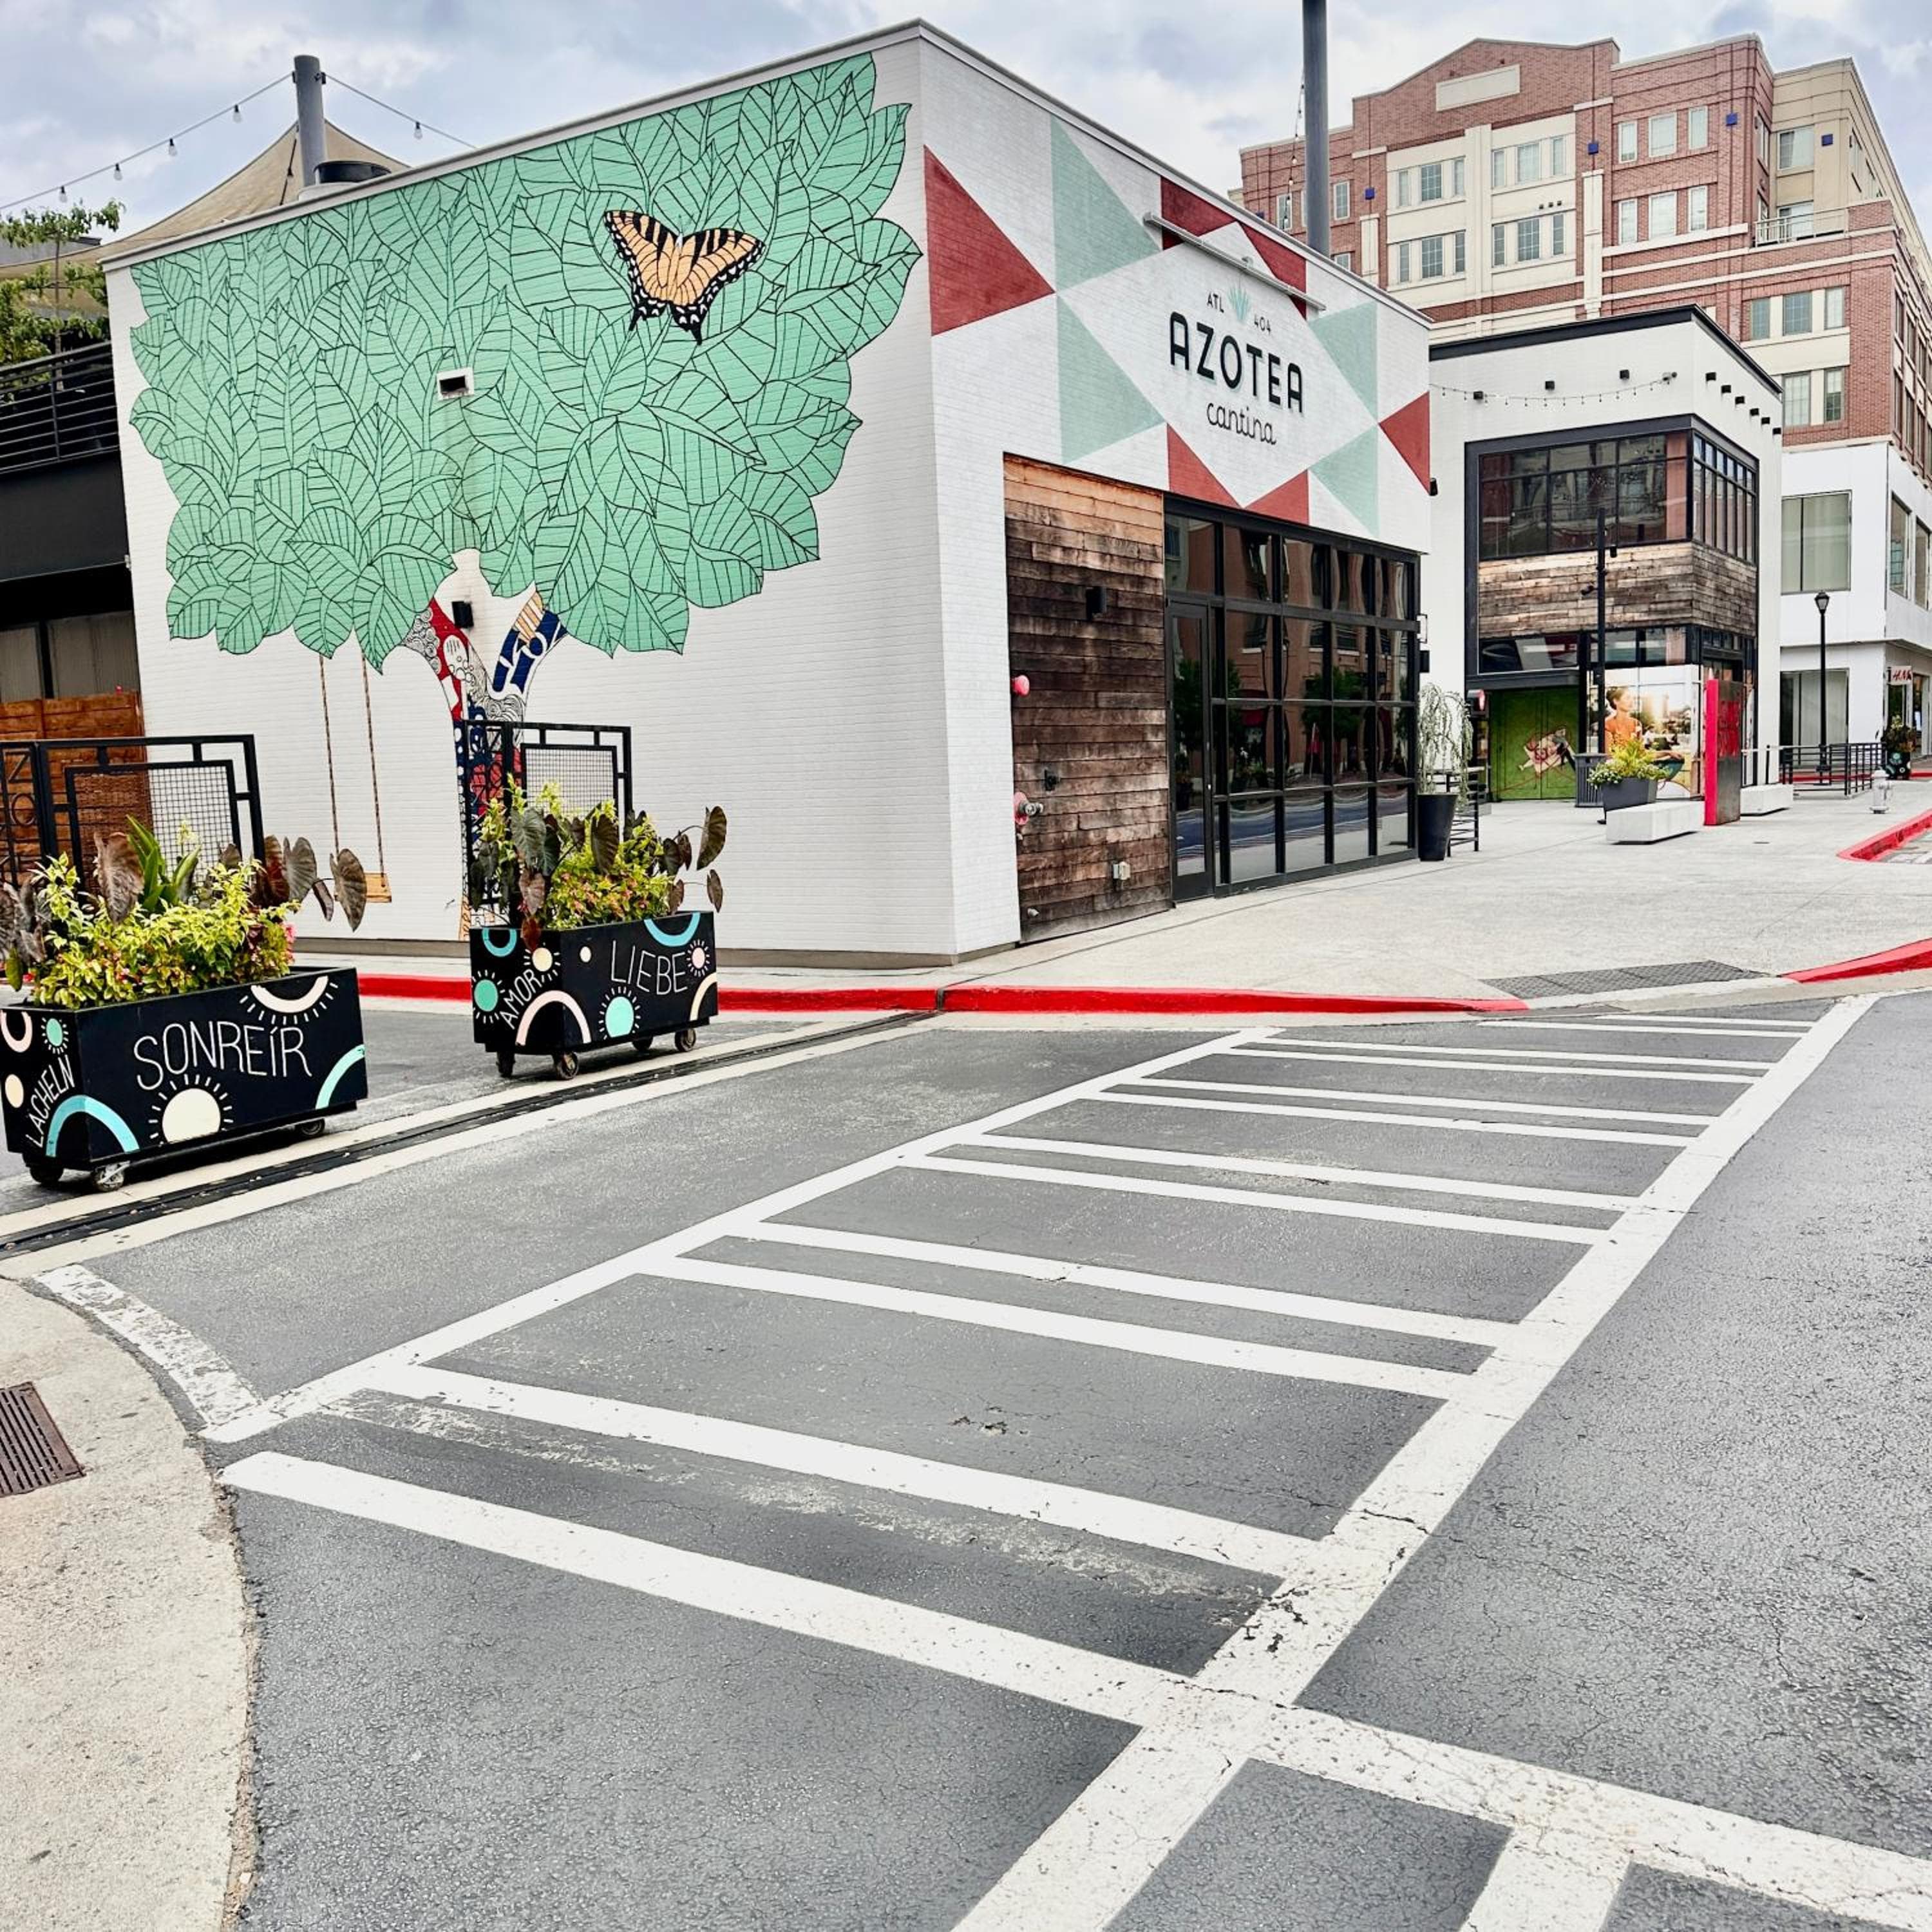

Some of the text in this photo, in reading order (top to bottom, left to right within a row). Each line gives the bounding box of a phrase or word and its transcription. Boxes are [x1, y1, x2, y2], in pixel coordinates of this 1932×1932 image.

[1207, 291, 1224, 313] ATL
[1254, 314, 1271, 335] 404
[1170, 311, 1302, 413] AZOTEA
[1206, 402, 1276, 445] cantina
[611, 940, 688, 995] LIEBE
[499, 968, 542, 1030] AMOR
[133, 1021, 312, 1090] SONREÍR
